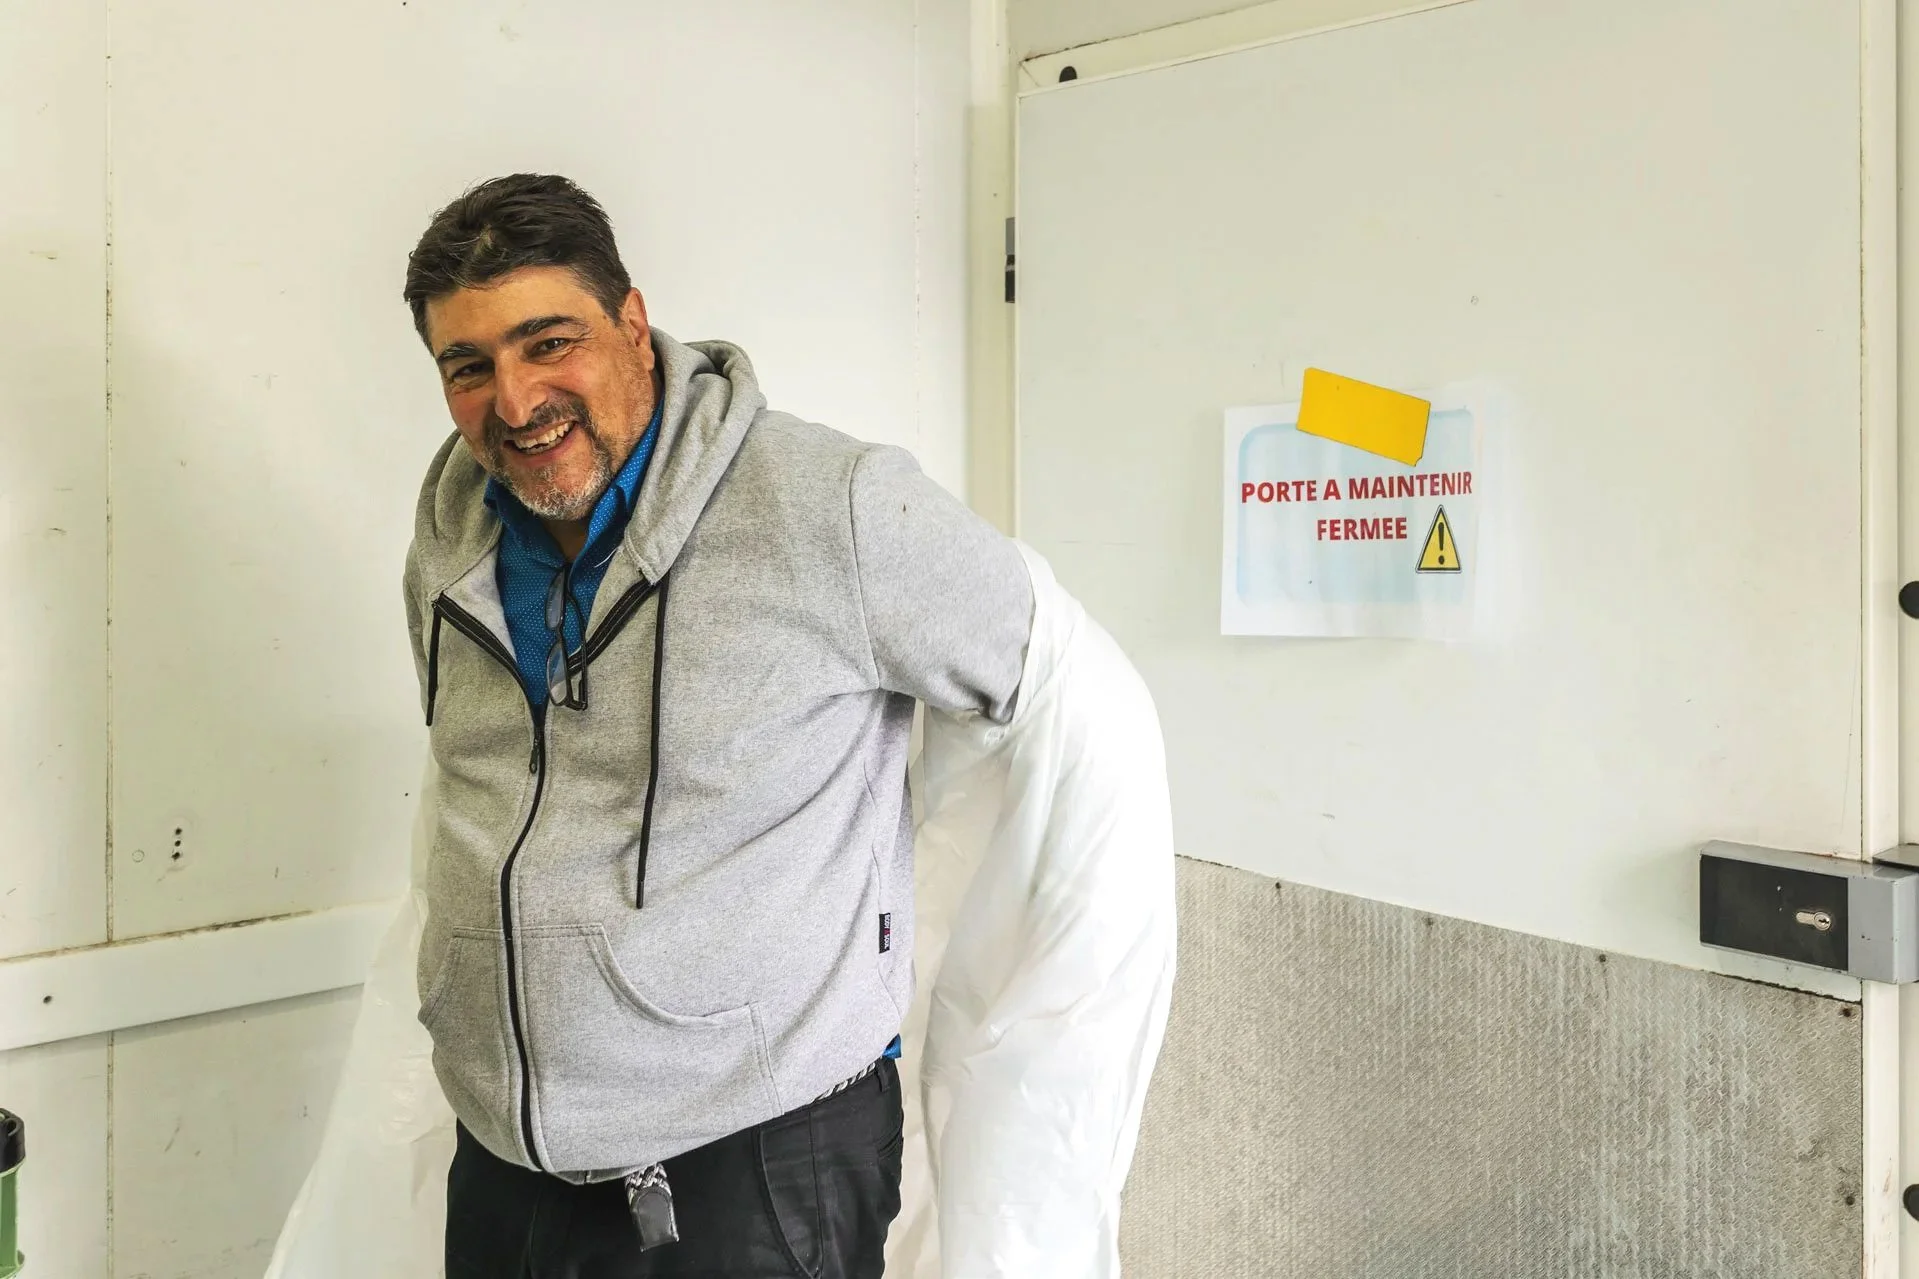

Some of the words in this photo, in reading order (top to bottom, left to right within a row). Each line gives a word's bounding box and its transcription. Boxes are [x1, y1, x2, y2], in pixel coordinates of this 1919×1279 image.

[1241, 480, 1317, 503] PORTE
[1323, 479, 1341, 501] A
[1348, 471, 1472, 500] MAINTENIR
[1316, 517, 1408, 541] FERMEE
